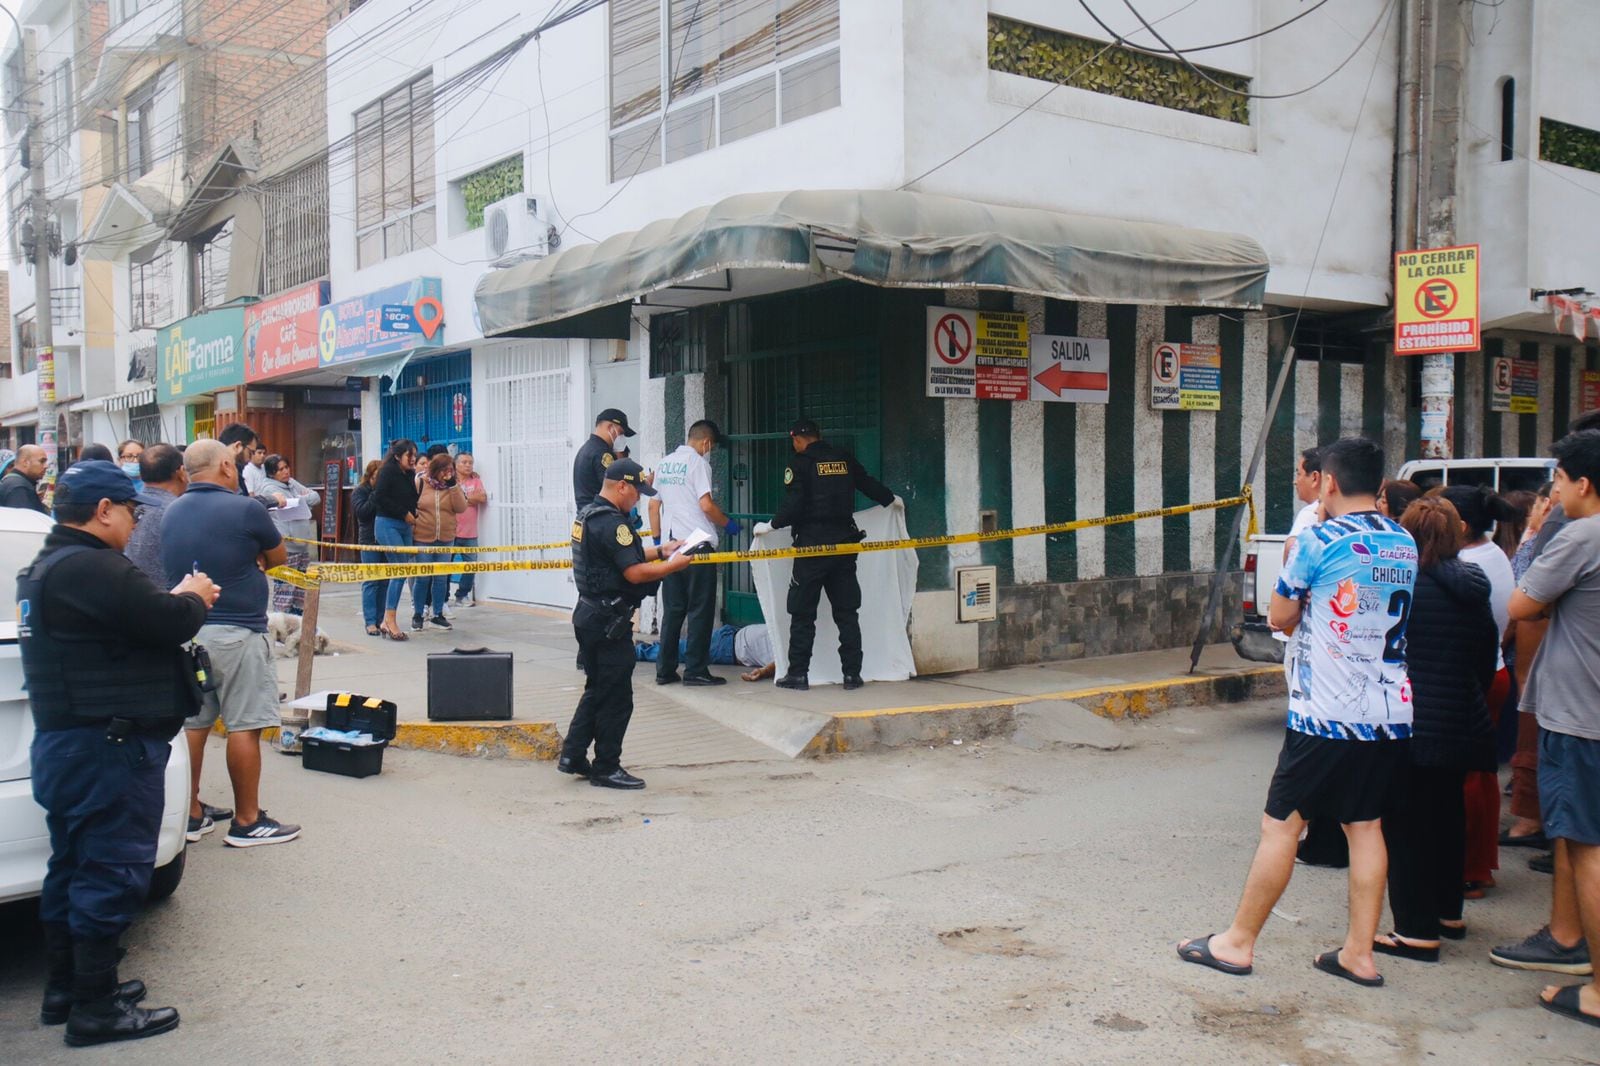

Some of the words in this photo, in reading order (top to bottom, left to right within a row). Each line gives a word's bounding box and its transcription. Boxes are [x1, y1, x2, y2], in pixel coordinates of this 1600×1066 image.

[1400, 255, 1417, 267] NO
[1421, 249, 1475, 265] CERRAR
[1408, 267, 1423, 278] LA
[1426, 263, 1466, 276] CALLE
[1399, 334, 1474, 349] ESTACIONAR
[1051, 340, 1091, 361] SALIDA
[819, 463, 846, 473] POLICIA
[385, 565, 418, 577] PASAR
[421, 564, 434, 574] NO
[463, 562, 510, 573] PELIGRO
[1372, 566, 1412, 585] CHICLLA
[1382, 589, 1411, 664] 2
